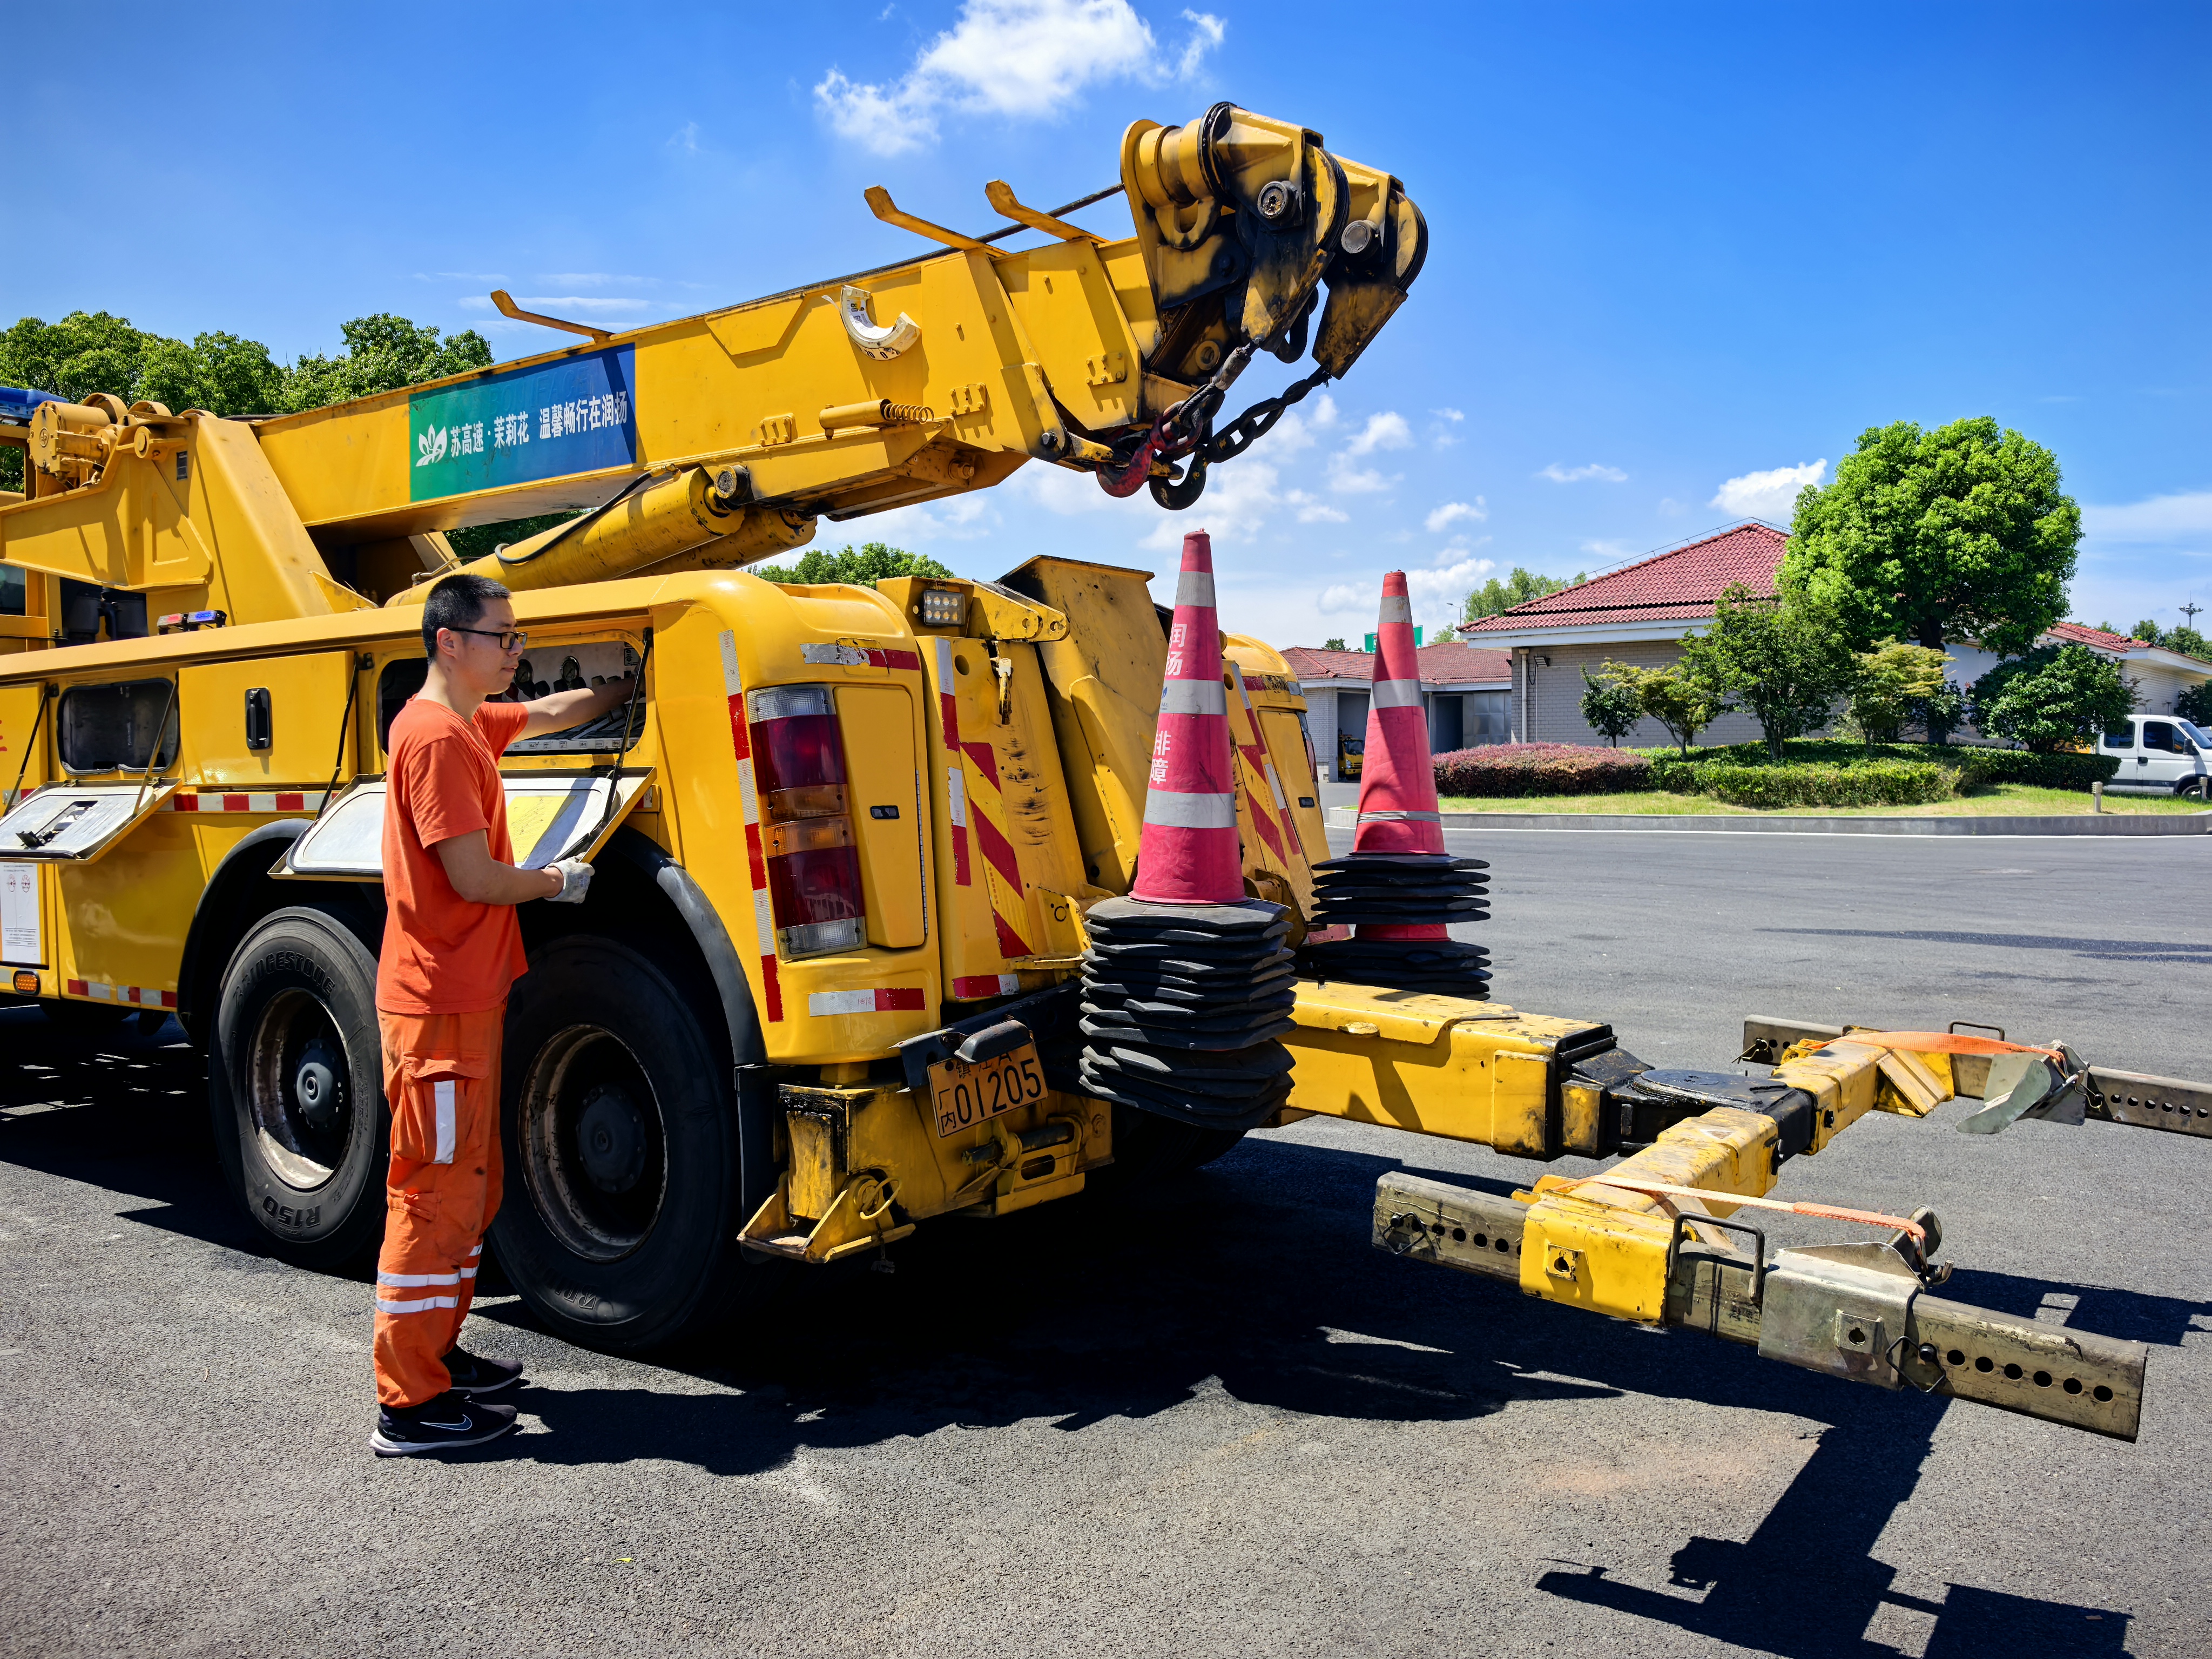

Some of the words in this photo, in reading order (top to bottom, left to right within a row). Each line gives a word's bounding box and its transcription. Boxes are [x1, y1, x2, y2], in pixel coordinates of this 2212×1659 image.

[450, 411, 529, 457] 苏高速·茉莉花
[539, 390, 627, 440] 温馨畅行在润扬
[954, 1058, 1041, 1124] 01205
[262, 1195, 321, 1228] R150
